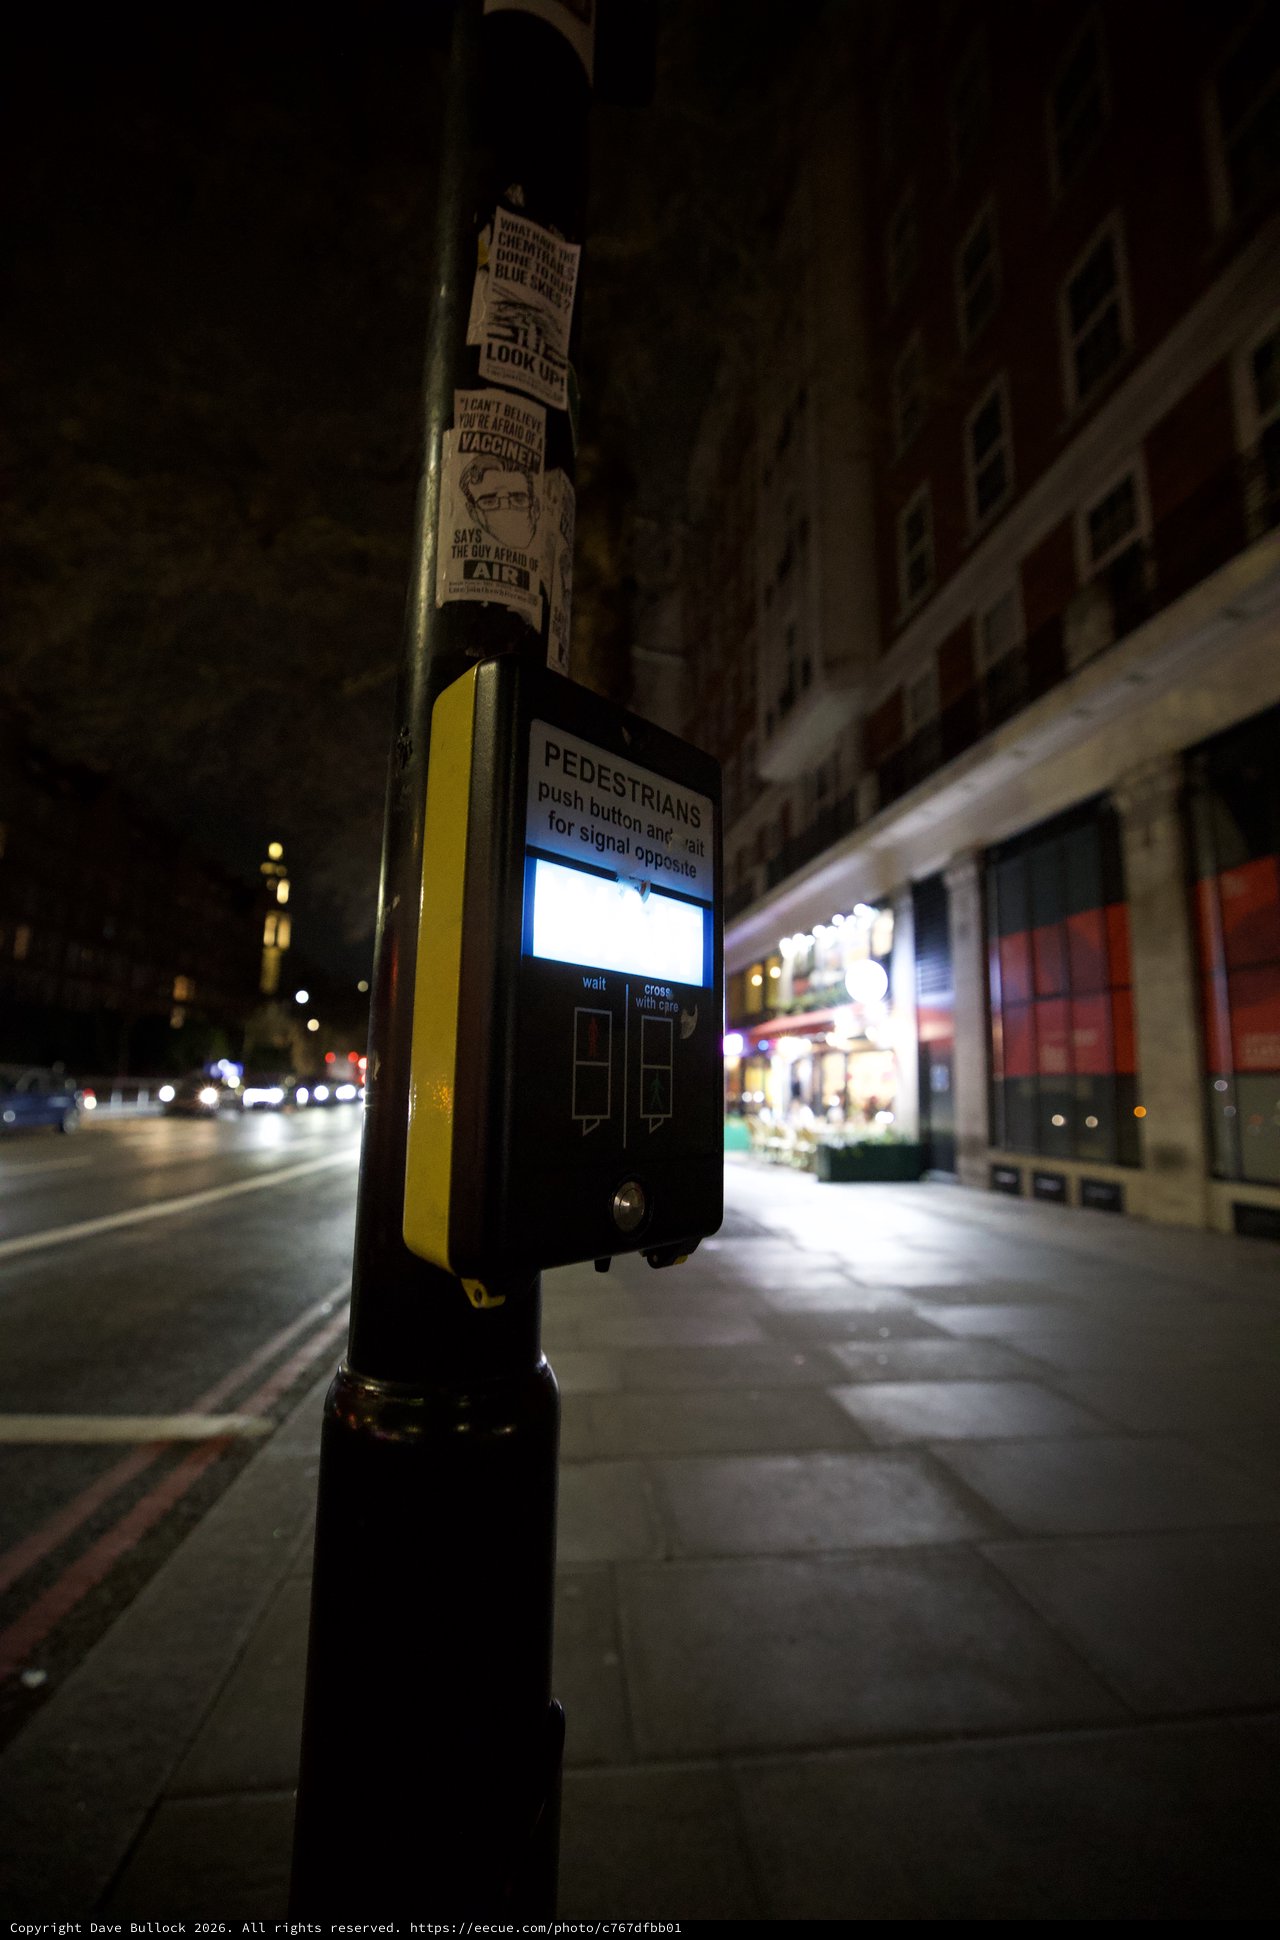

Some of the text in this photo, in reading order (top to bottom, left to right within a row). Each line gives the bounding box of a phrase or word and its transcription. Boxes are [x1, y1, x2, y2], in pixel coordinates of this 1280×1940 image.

[501, 217, 530, 238] WHAT
[559, 248, 576, 264] THE
[496, 248, 529, 268] DONE
[535, 263, 549, 279] TO
[498, 232, 575, 282] CHEMTRAILS
[495, 263, 527, 286] BLUE
[486, 343, 534, 373] LOOK
[539, 361, 565, 392] UP!
[470, 398, 502, 412] CAN'T
[504, 404, 544, 432] BELIEVE
[459, 413, 544, 454] YOU'RE AFRAID OF A
[454, 528, 482, 544] SAYS
[452, 545, 540, 572] THE GUY AFRAID OF
[472, 561, 518, 585] AIR
[545, 740, 701, 829] PEDESTRIANS
[538, 781, 583, 812] push
[590, 797, 641, 834] button
[682, 837, 704, 857] ait
[548, 810, 697, 879] for signal opposite
[583, 976, 607, 991] wait
[644, 984, 674, 998] cross
[636, 996, 679, 1013] with care
